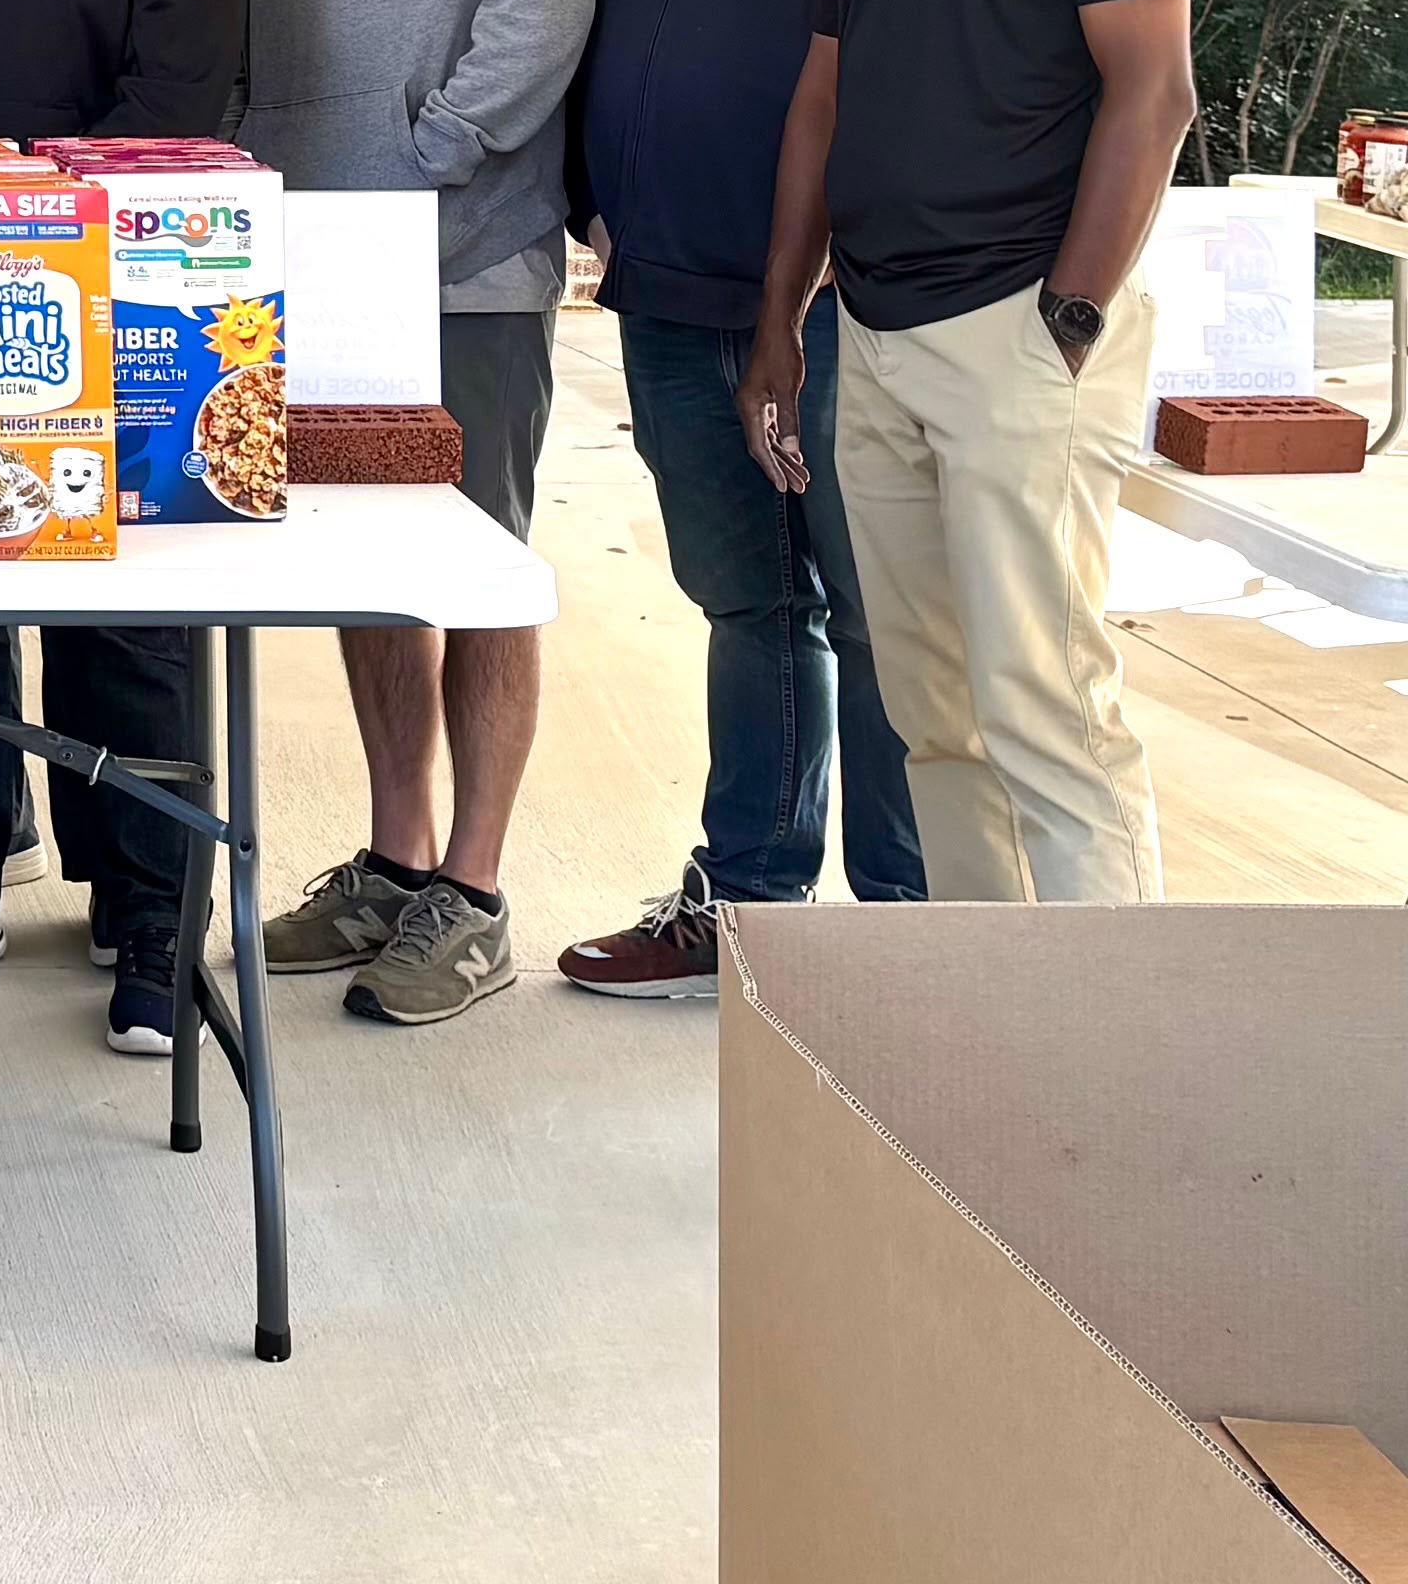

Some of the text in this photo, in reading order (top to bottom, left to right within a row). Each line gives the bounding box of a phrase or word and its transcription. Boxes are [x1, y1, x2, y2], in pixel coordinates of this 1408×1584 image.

[17, 194, 76, 216] SIZE
[115, 206, 252, 240] spoons
[114, 328, 179, 350] IBER
[114, 353, 174, 365] UPPORTS
[134, 369, 187, 381] HEALTH
[0, 418, 90, 430] HIGH FIBER
